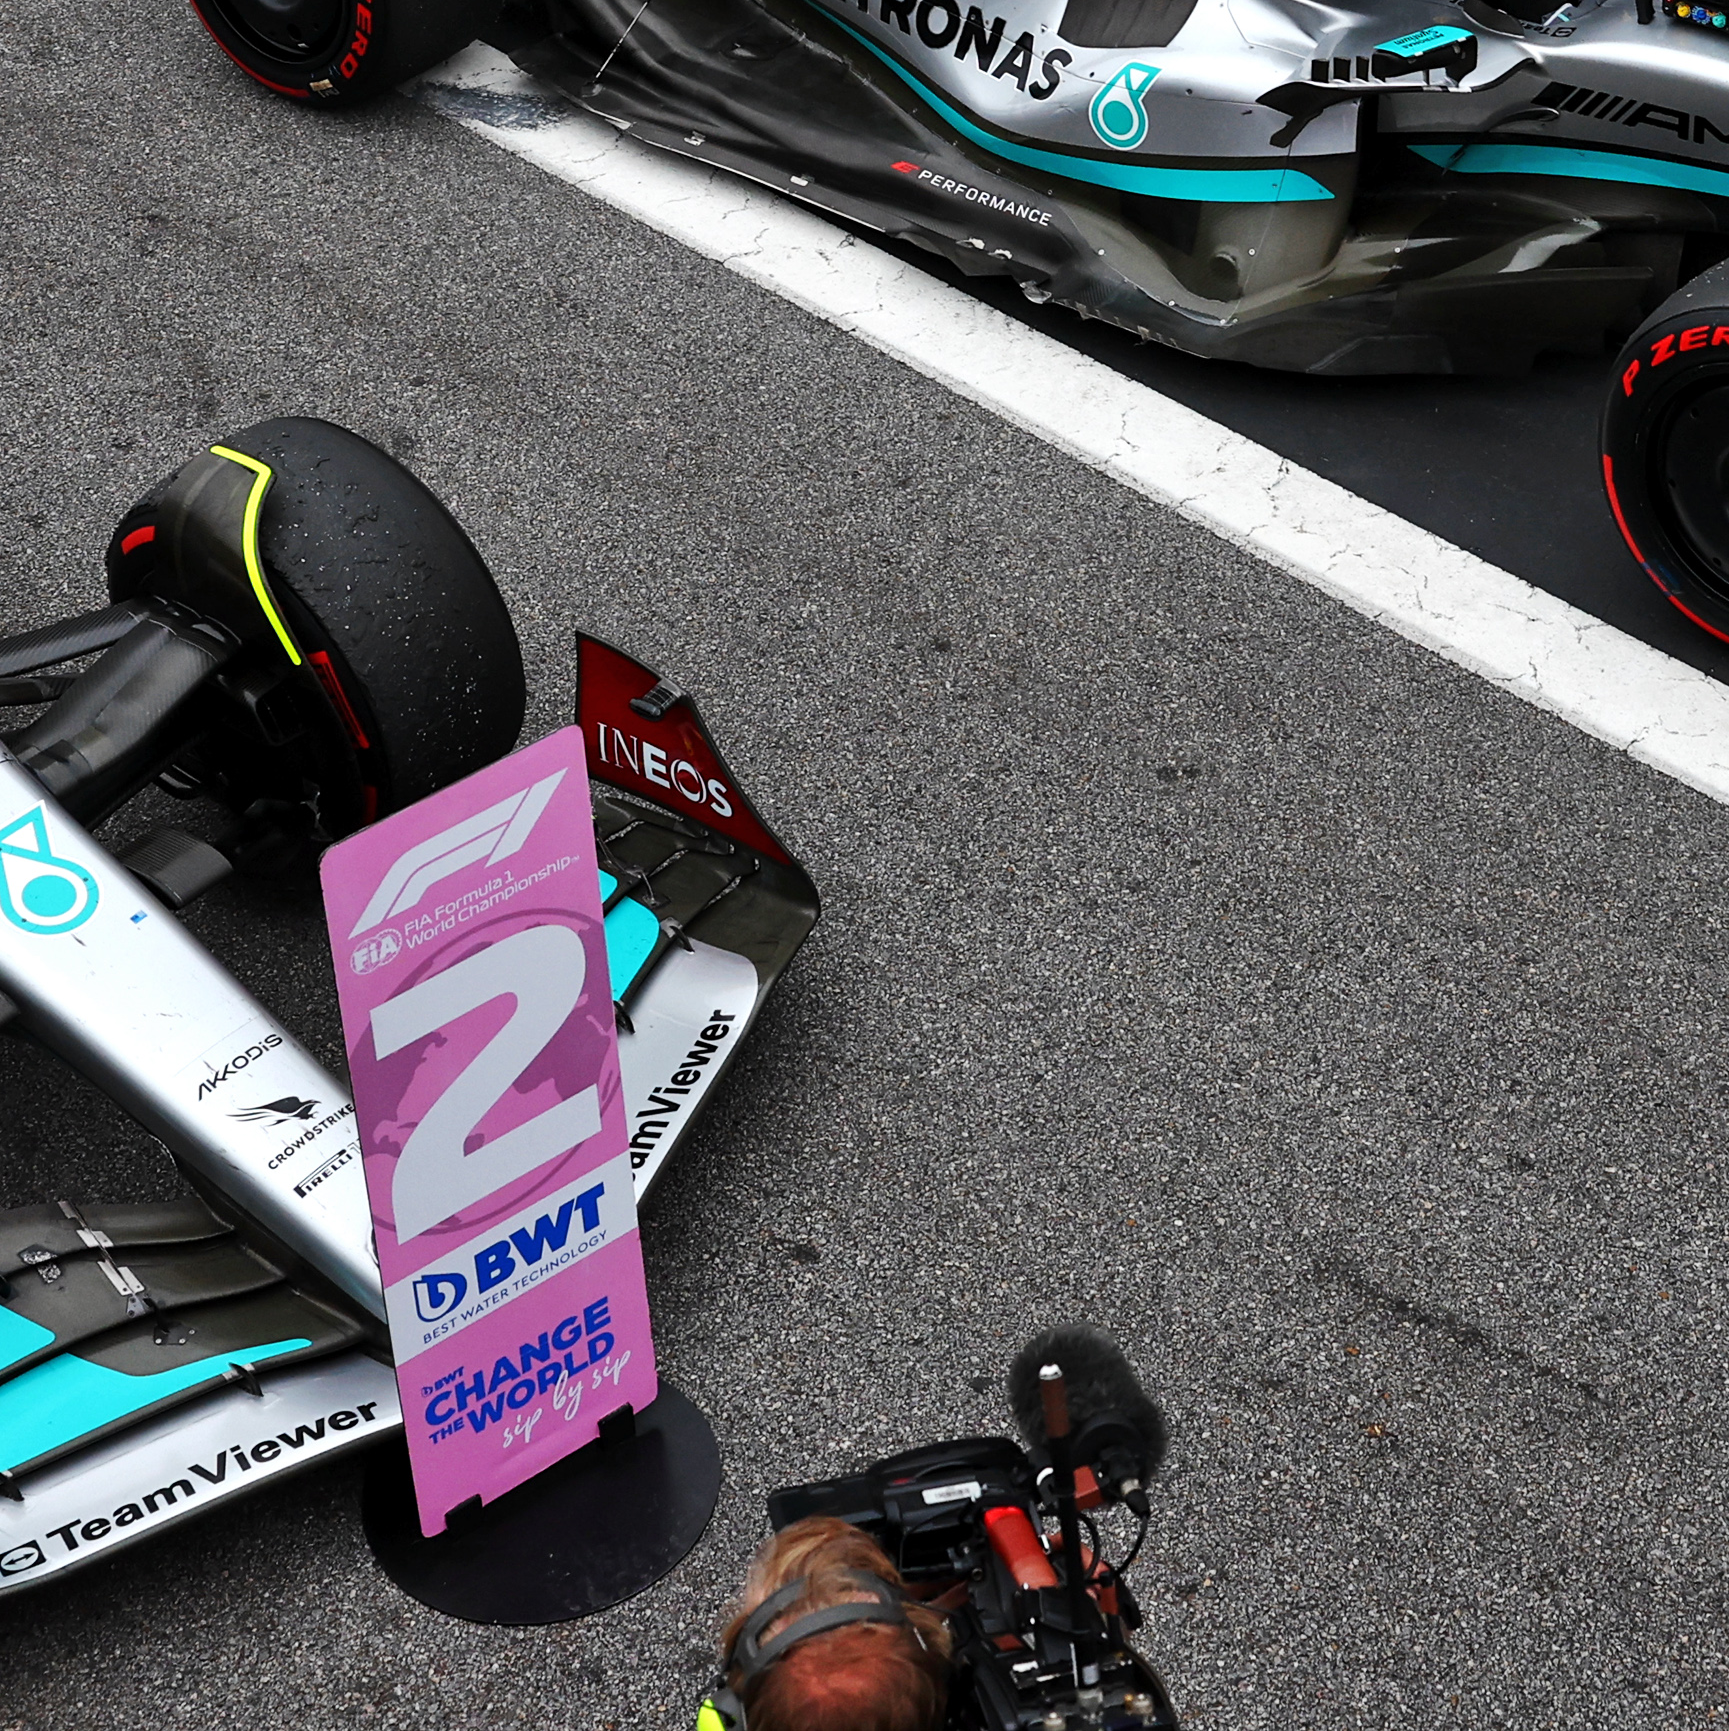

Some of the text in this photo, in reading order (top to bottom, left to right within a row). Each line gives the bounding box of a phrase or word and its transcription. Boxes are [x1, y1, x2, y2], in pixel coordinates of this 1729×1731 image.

[1622, 359, 1641, 397] P
[597, 722, 733, 818] INEOS
[405, 856, 571, 949] World Championship
[405, 870, 514, 936] FIA Formula 1
[370, 924, 603, 1246] 2
[268, 1103, 356, 1170] CROWDSTRIKE
[293, 1148, 353, 1199] PIRELLI
[423, 1230, 608, 1345] BEST WATER TECHNOLOGY
[474, 1181, 605, 1295] BWT
[425, 1296, 612, 1425] CHANGE
[429, 1332, 615, 1445] THE WORLD
[503, 1350, 631, 1449] sip by sip
[48, 1398, 378, 1553] TeamViewer
